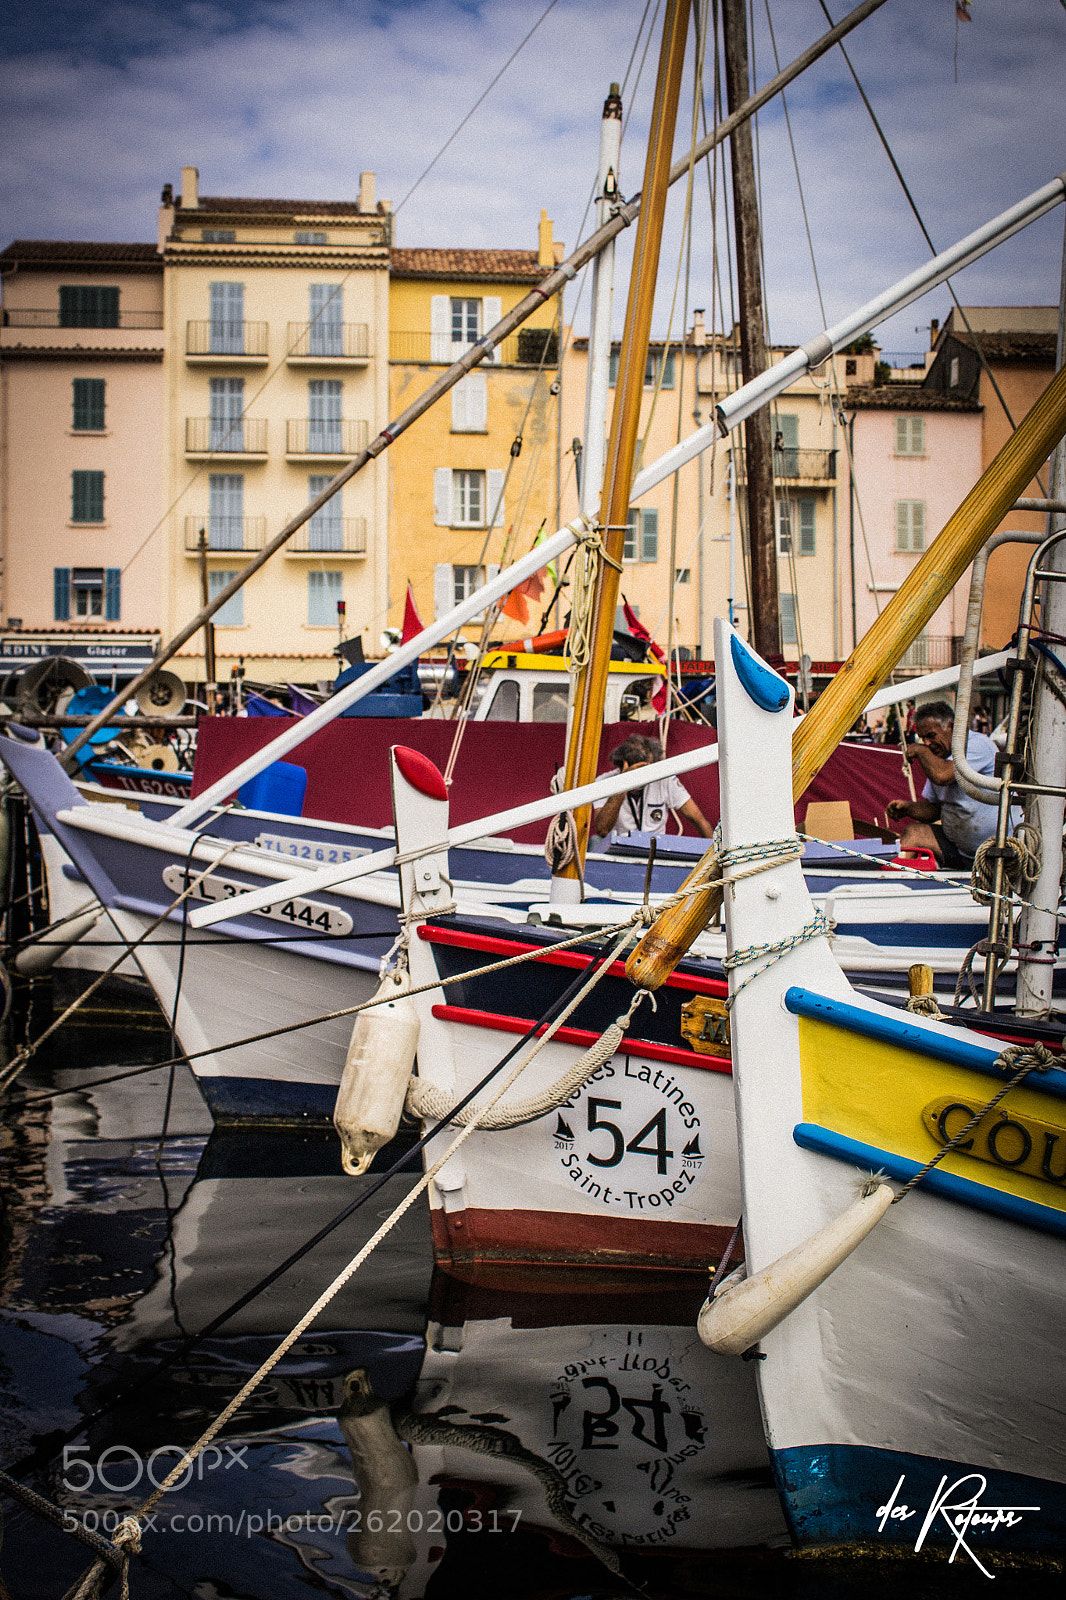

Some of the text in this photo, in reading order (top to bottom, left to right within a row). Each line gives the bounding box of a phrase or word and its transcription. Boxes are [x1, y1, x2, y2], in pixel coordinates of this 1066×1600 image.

[0, 645, 49, 655] RDINE
[87, 646, 128, 656] Glacier
[281, 901, 332, 931] 444
[624, 1055, 701, 1129] Latines
[554, 1140, 575, 1151] 2017
[586, 1096, 674, 1176] 54
[681, 1159, 703, 1169] 2017
[561, 1153, 696, 1209] Saint-Tropez
